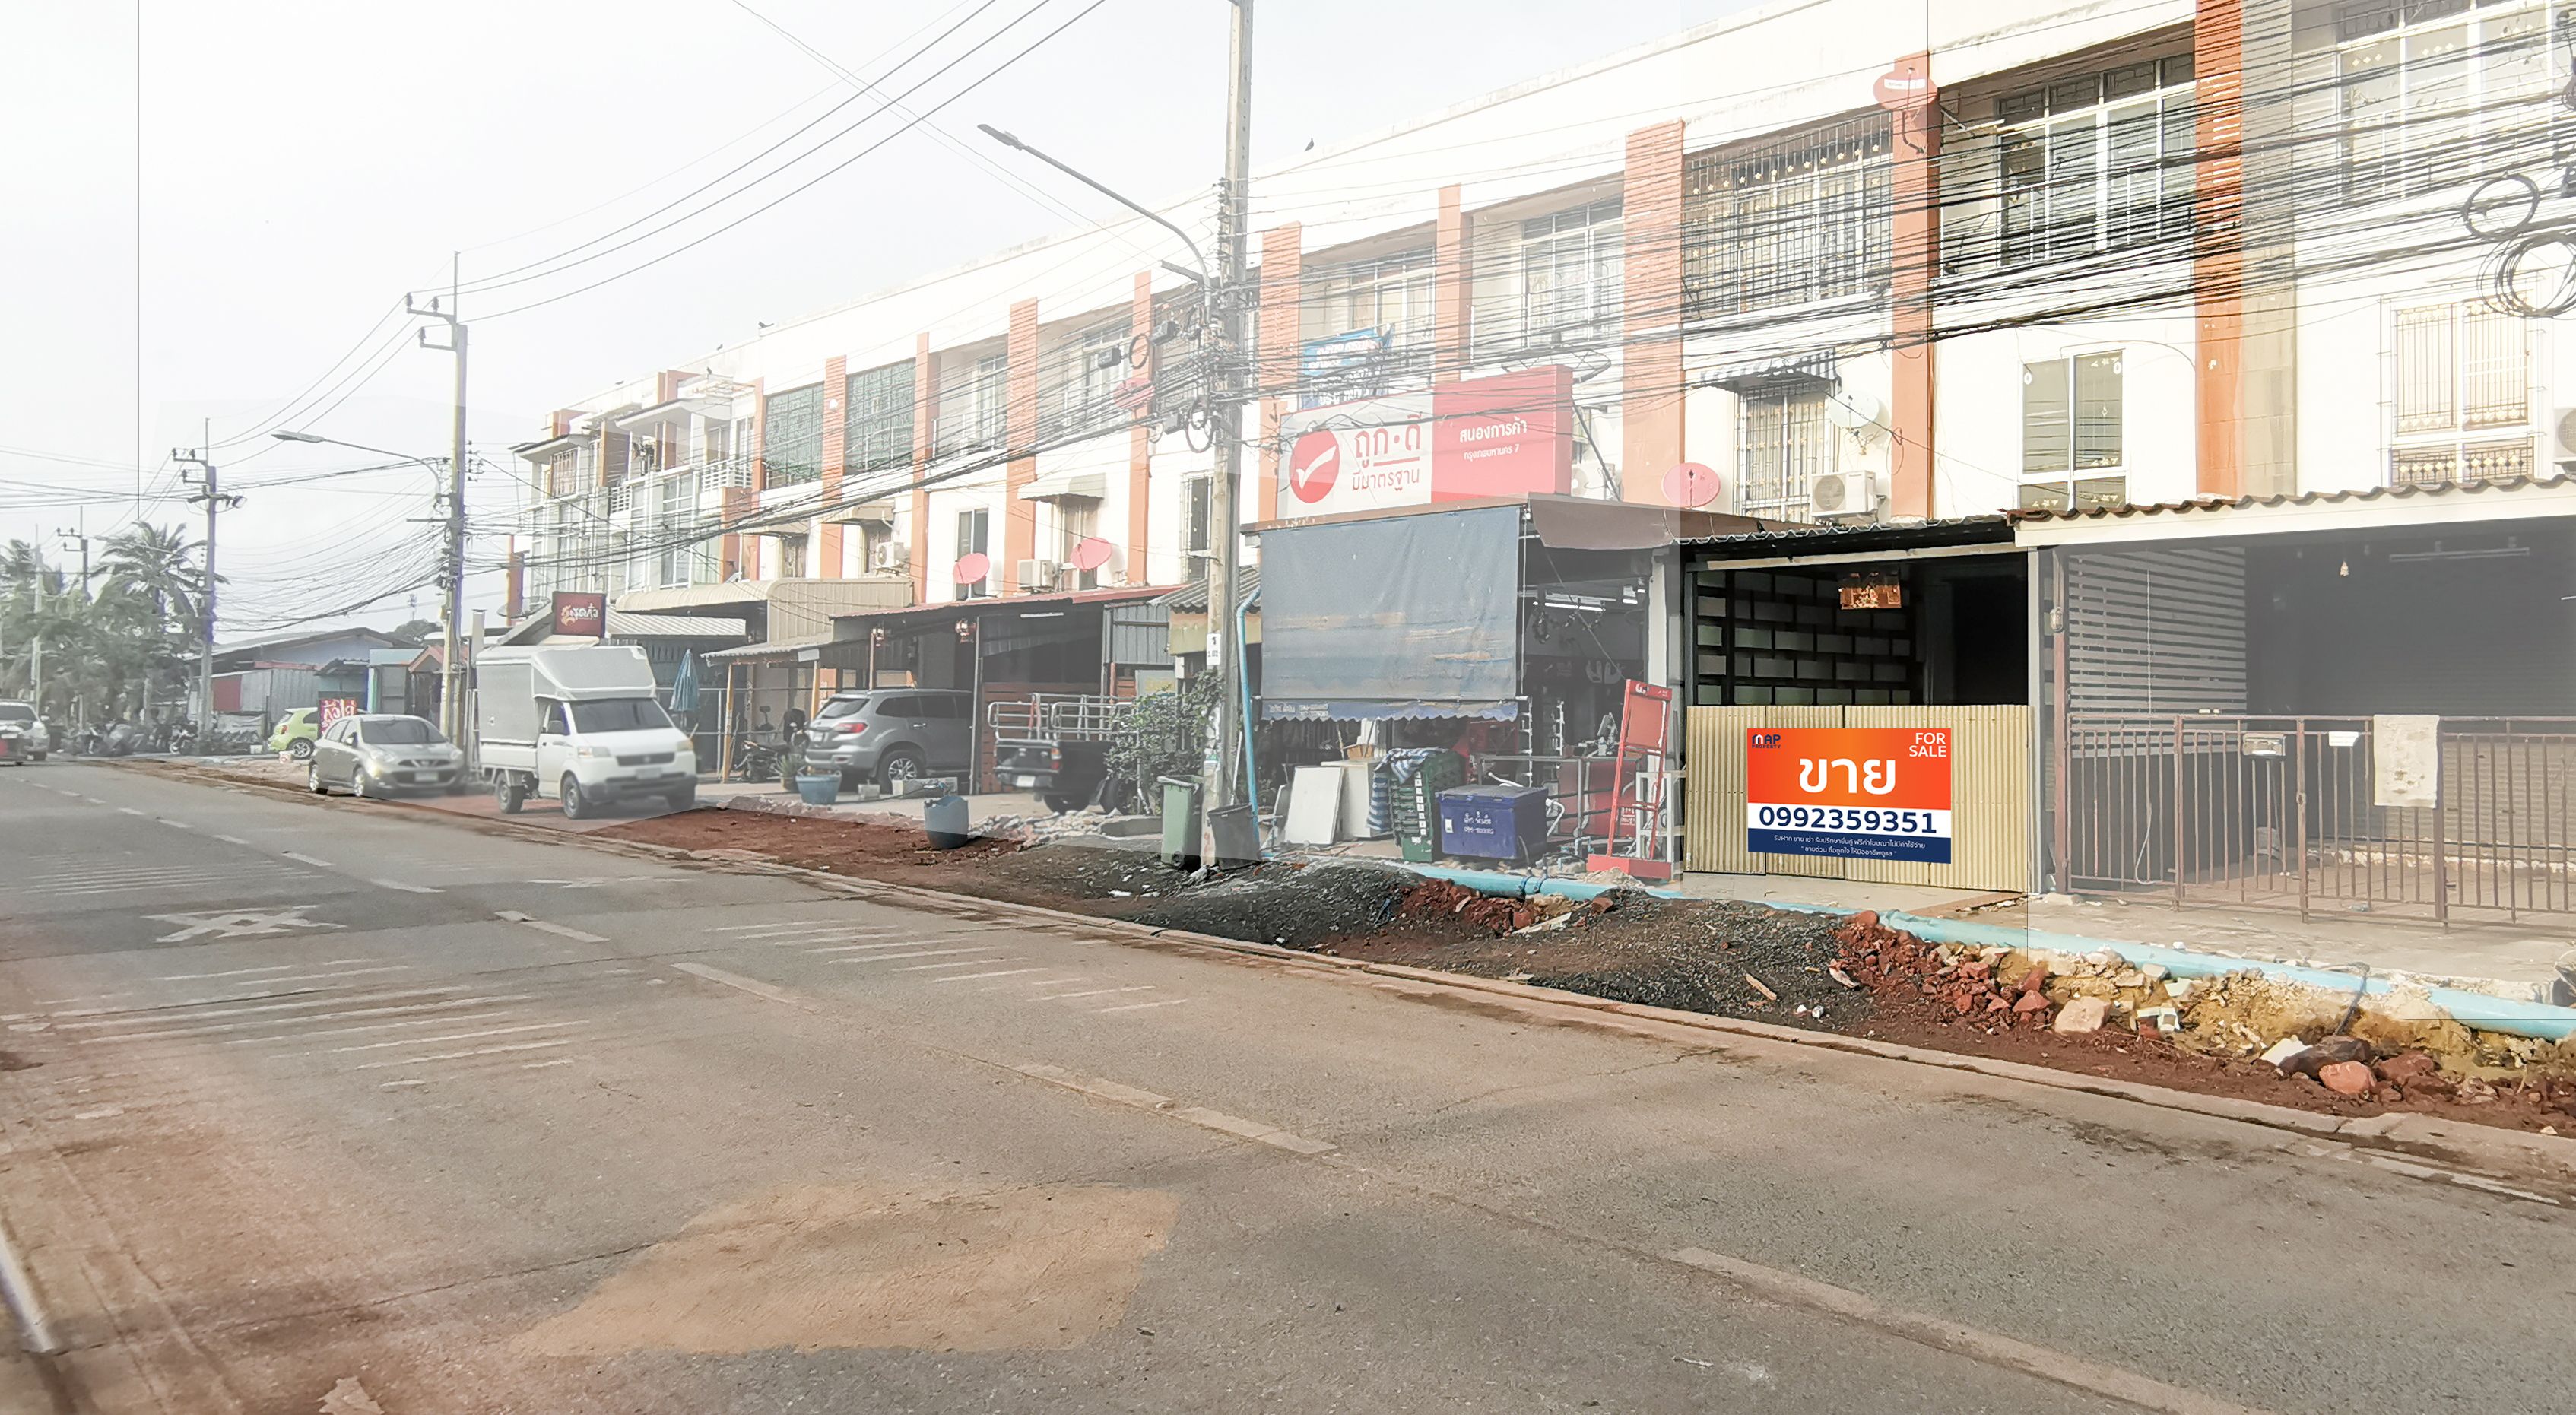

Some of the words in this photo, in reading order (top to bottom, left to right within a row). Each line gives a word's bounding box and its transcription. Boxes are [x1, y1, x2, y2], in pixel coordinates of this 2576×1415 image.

[1460, 416, 1528, 443] สนองการค้า
[1353, 468, 1420, 491] มีมาตรฐาน
[1752, 734, 1781, 744] MAP
[1915, 732, 1946, 744] FOR
[1909, 745, 1947, 757] SALE
[1799, 758, 1896, 795] ขาย
[1759, 806, 1937, 834] 0992359351
